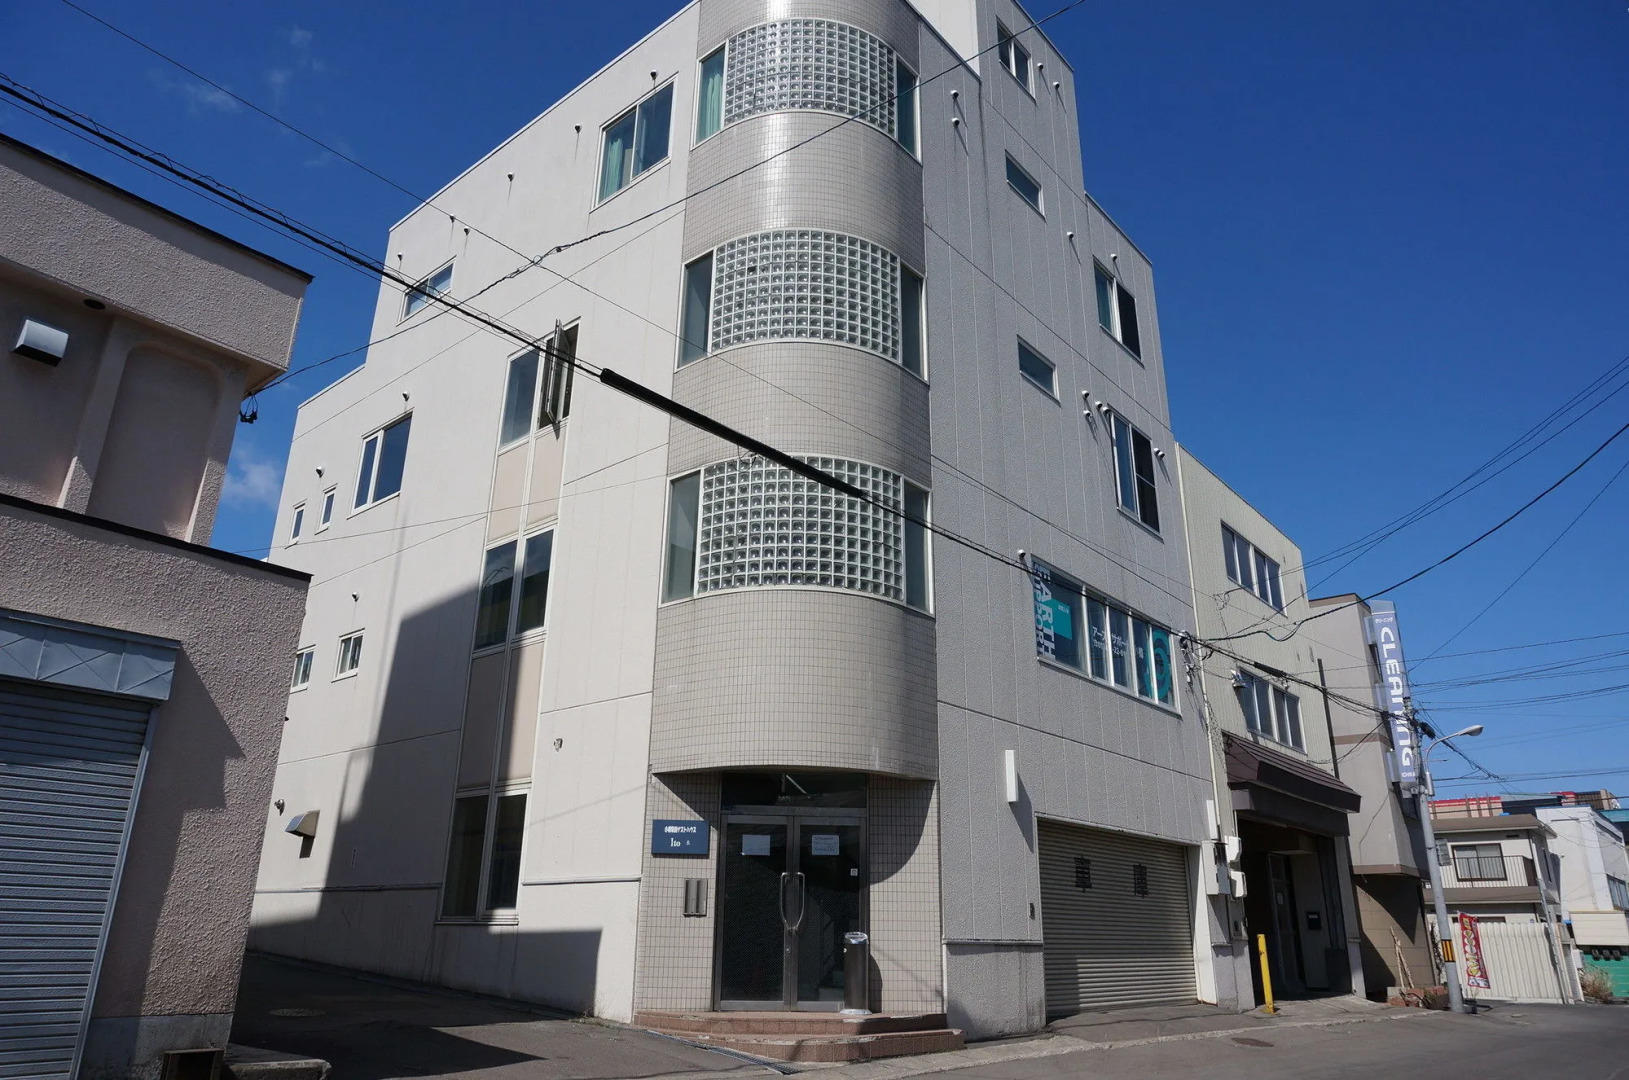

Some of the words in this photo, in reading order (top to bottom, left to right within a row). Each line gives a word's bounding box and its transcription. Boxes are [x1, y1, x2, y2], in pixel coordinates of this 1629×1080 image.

[1035, 564, 1055, 659] EARTH
[1381, 627, 1412, 767] CLEANING
[670, 837, 681, 847] Ito
